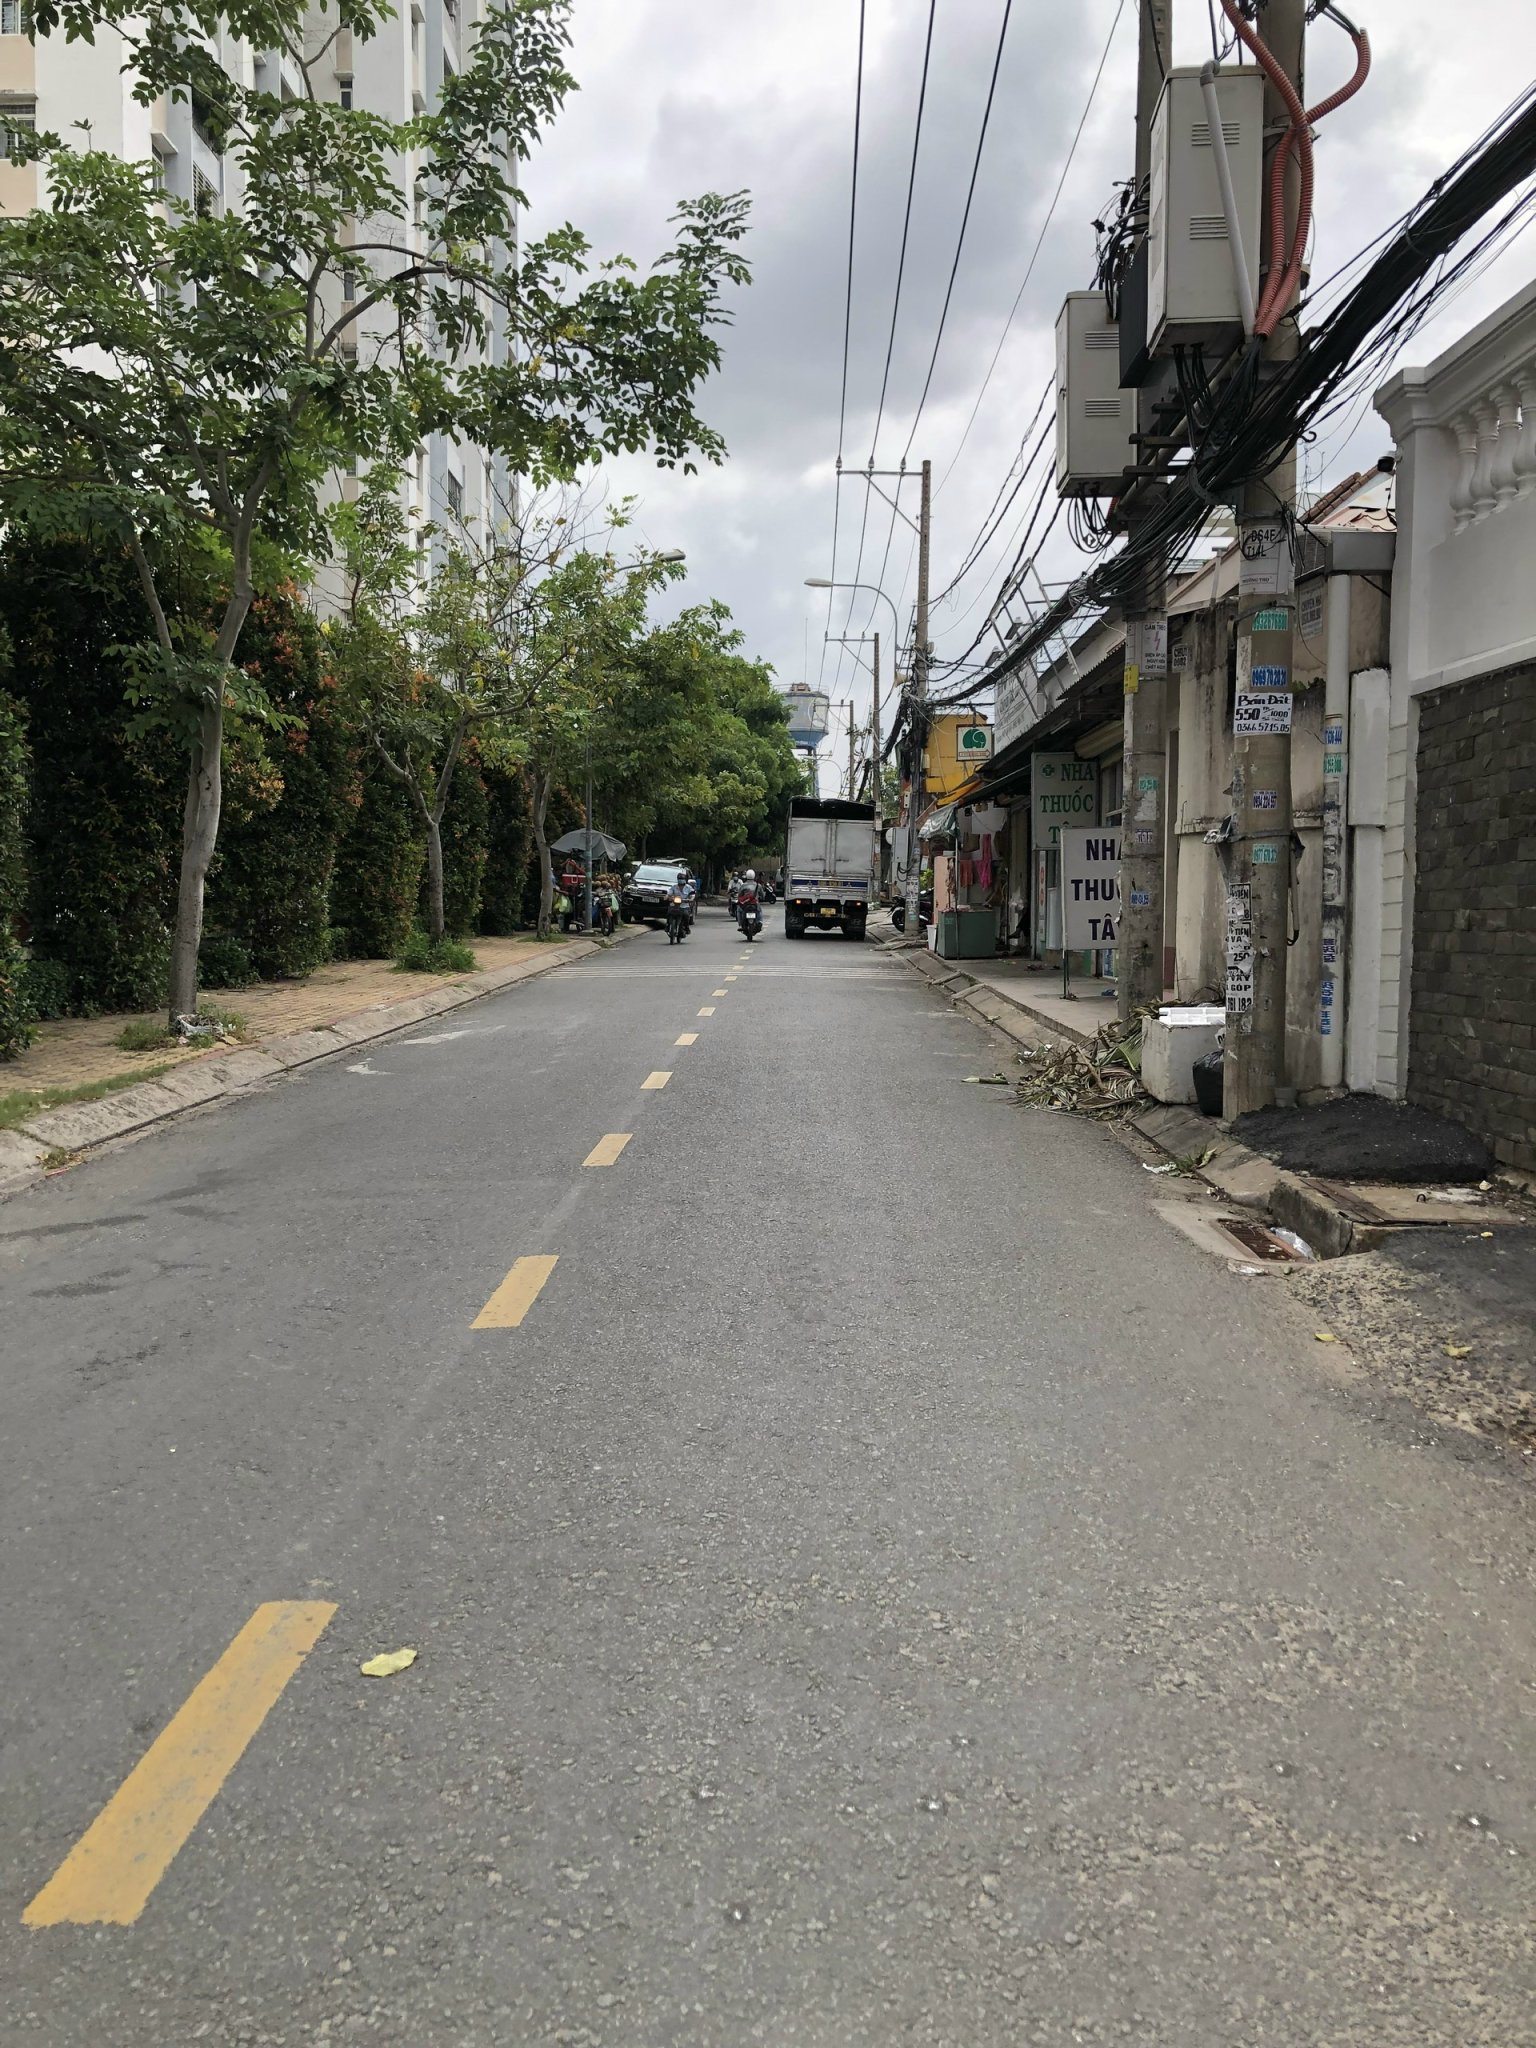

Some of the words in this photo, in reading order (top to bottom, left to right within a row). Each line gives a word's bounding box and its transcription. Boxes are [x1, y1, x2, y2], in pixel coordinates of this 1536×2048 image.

[1238, 694, 1266, 706] Bán
[1235, 708, 1260, 720] 550
[1040, 786, 1093, 813] THUỐC
[1071, 879, 1121, 901] THU
[1230, 982, 1252, 992] GÓP
